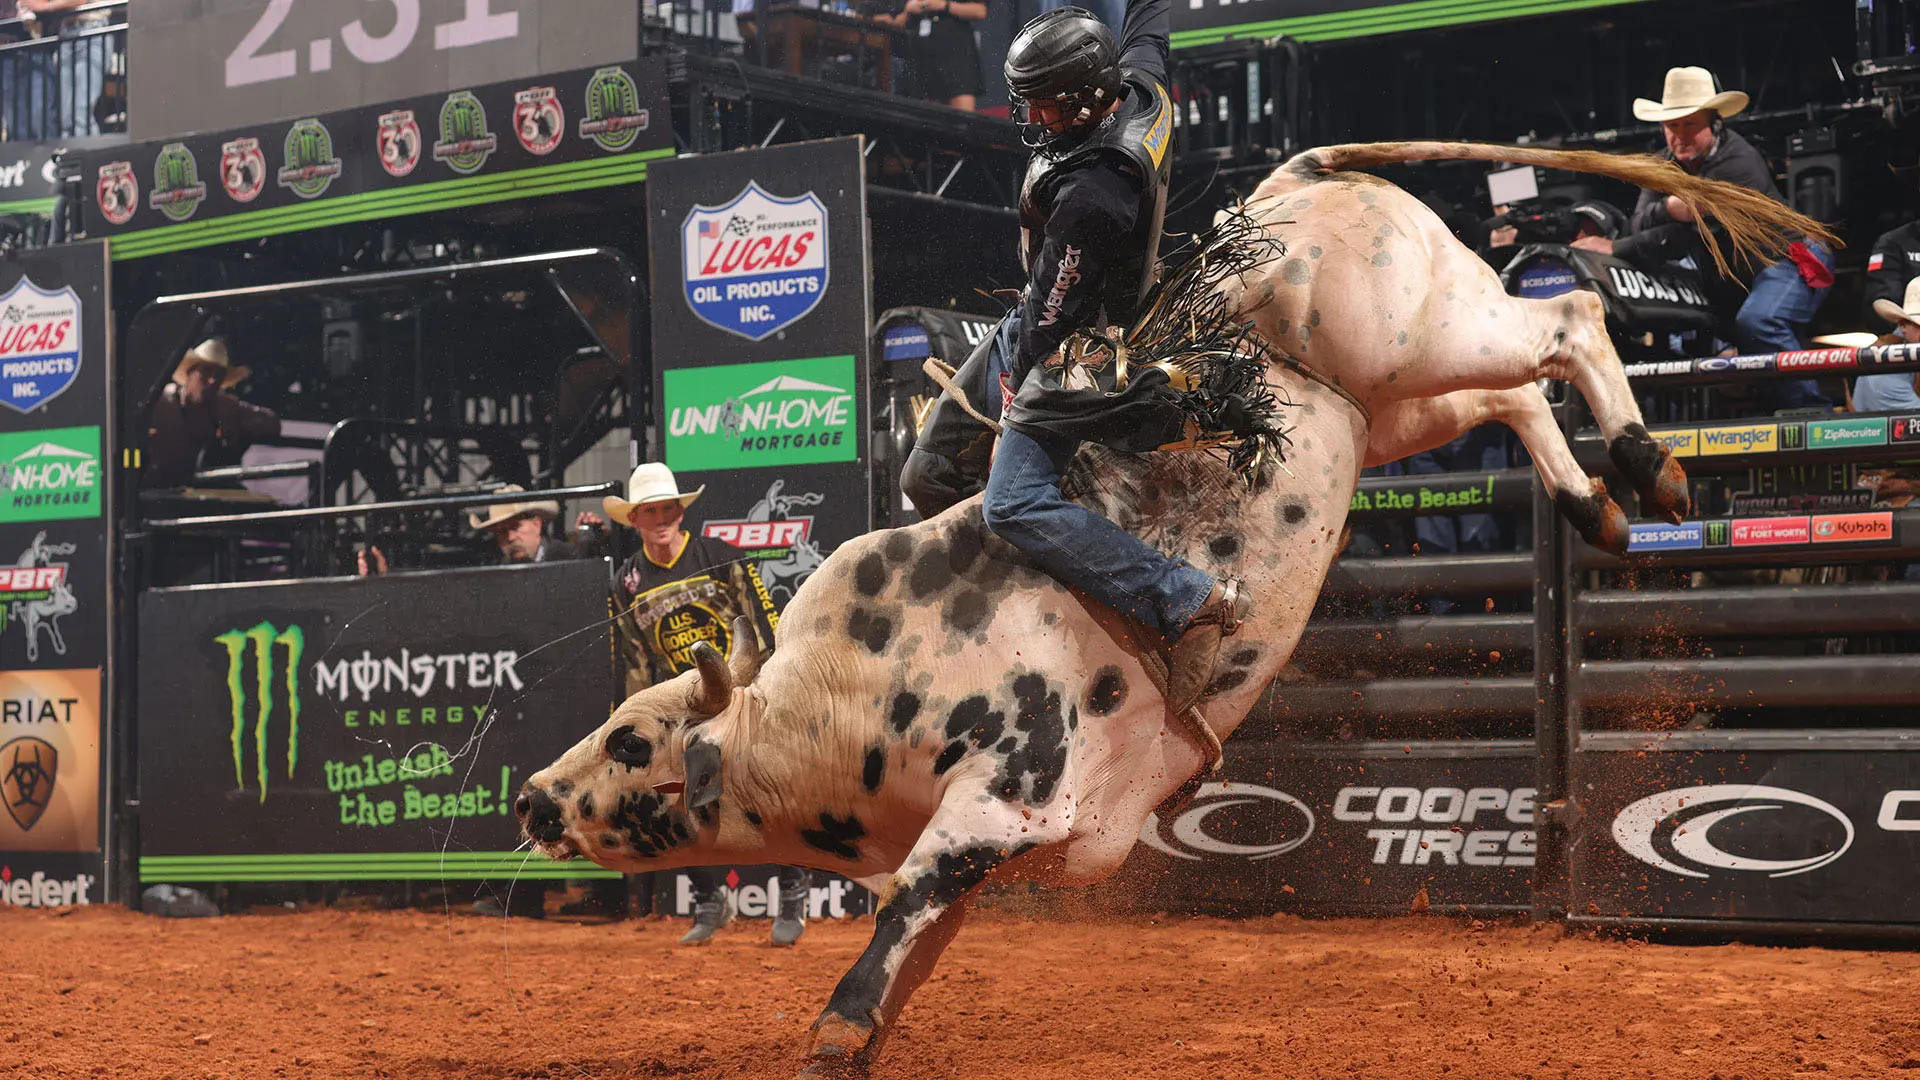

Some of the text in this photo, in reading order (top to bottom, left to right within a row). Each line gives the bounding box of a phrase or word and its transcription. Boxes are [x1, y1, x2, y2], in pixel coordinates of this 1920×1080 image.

[756, 218, 818, 232] PERFORMANCE
[700, 231, 815, 276] LUCAS
[693, 275, 819, 304] OIL PRODUCTS
[1038, 243, 1082, 328] Wrangler
[1544, 274, 1577, 286] SPORTS
[1609, 266, 1679, 302] LUCAS
[740, 304, 776, 323] INC.
[0, 320, 71, 355] UCAS
[1781, 349, 1852, 367] LUCAS OIL
[1870, 343, 1920, 364] YET
[2, 357, 75, 379] PRODUCTS
[12, 381, 41, 398] INC.
[669, 395, 852, 437] UNINHOME
[741, 431, 844, 452] MORTGAGE
[1704, 428, 1772, 451] Wrangler
[1823, 427, 1882, 441] ZipRecruiter
[13, 490, 91, 508] MORTGAGE
[1375, 488, 1415, 508] the
[1418, 474, 1496, 508] Beast!
[708, 521, 805, 548] PBR
[1638, 529, 1700, 544] CBS SPORTS
[1838, 519, 1888, 534] Kubota
[315, 648, 524, 702] MONSTER
[2, 698, 78, 723] RIAT
[344, 704, 488, 728] ENERGY
[323, 743, 455, 794] Unleash
[338, 764, 512, 828] the Beast!
[1367, 828, 1537, 867] TIRES
